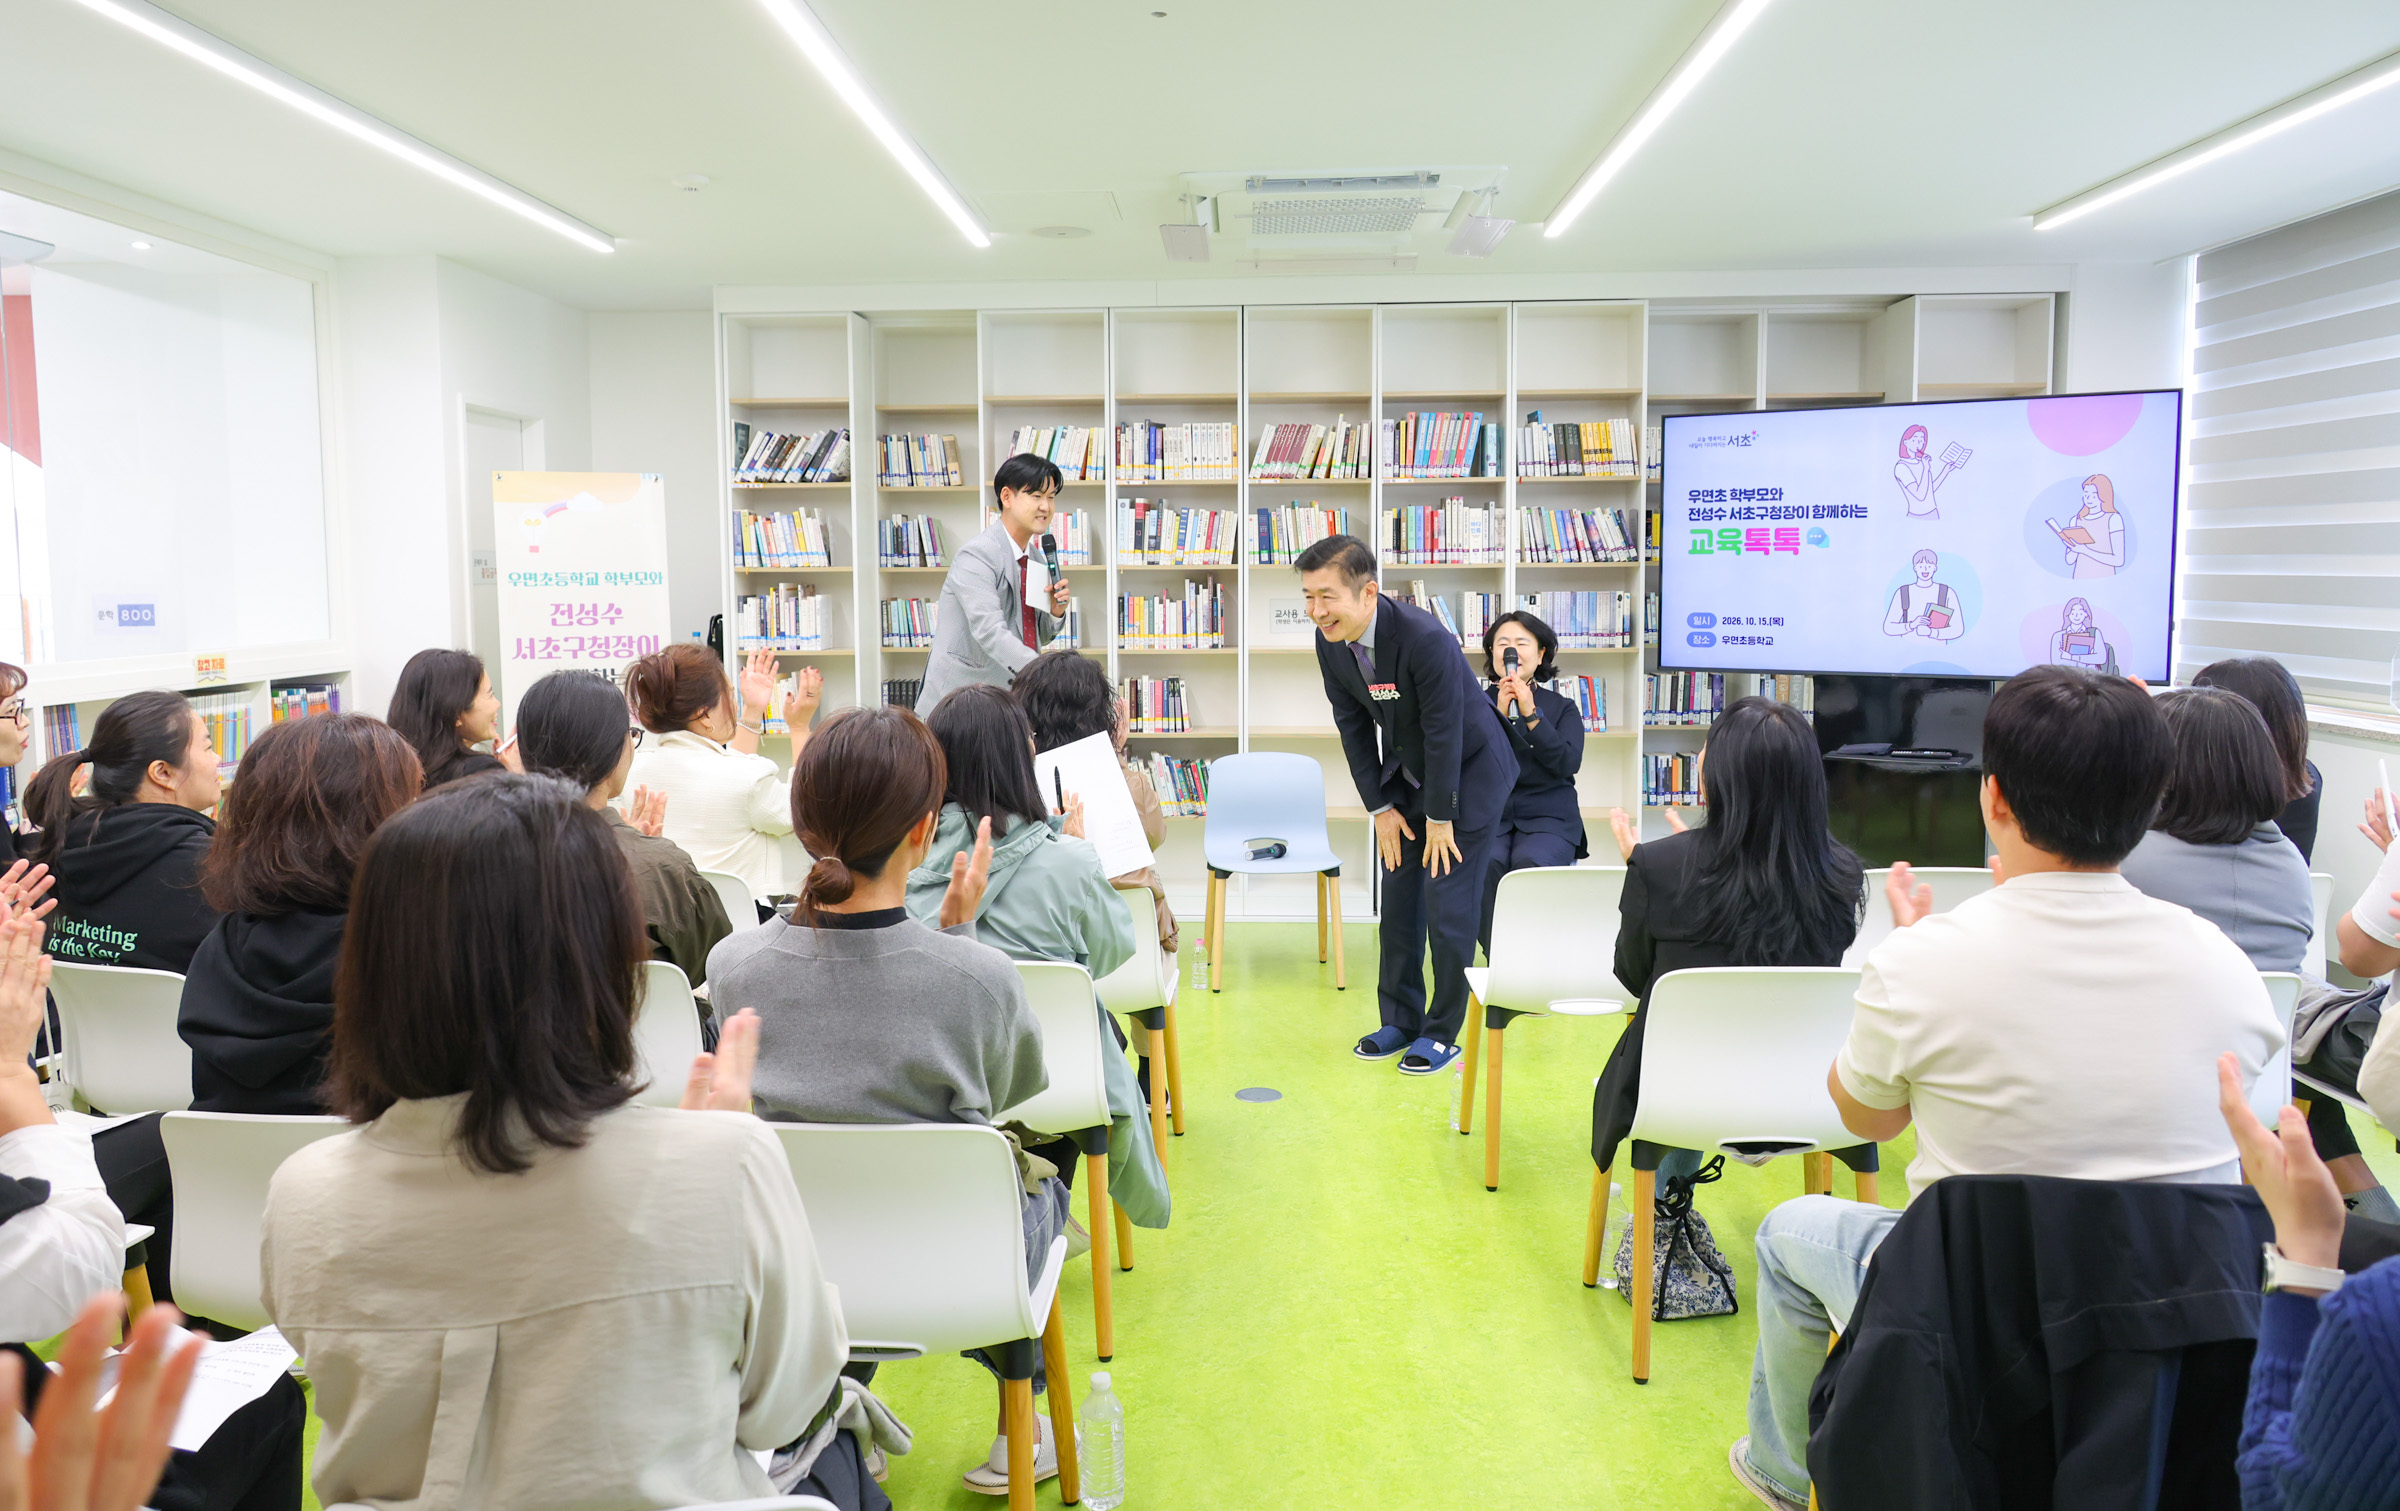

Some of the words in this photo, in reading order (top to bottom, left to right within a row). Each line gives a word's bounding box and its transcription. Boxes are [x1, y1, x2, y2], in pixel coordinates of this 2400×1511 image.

[1727, 433, 1752, 448] 서초
[1687, 488, 1728, 504] 우면초
[1729, 487, 1784, 502] 학부모와
[1687, 507, 1728, 522] 전성수
[1729, 505, 1810, 521] 서초구청장이
[1811, 504, 1869, 520] 함께하는
[1688, 527, 1801, 556] 교육톡톡
[507, 572, 600, 587] 우면초등학교
[603, 571, 664, 586] 학부모와
[121, 609, 152, 621] 800
[550, 603, 624, 627] 전성수
[1275, 609, 1298, 619] 교사용
[1693, 615, 1711, 626] 일시
[1722, 616, 1744, 626] 2026.
[512, 635, 660, 660] 서초구청장이
[1693, 634, 1711, 645] 장소
[1722, 635, 1774, 646] 우면초등학교
[1369, 689, 1401, 701] 전성수
[53, 914, 138, 952] Marketing
[48, 932, 61, 952] is
[61, 936, 86, 957] the
